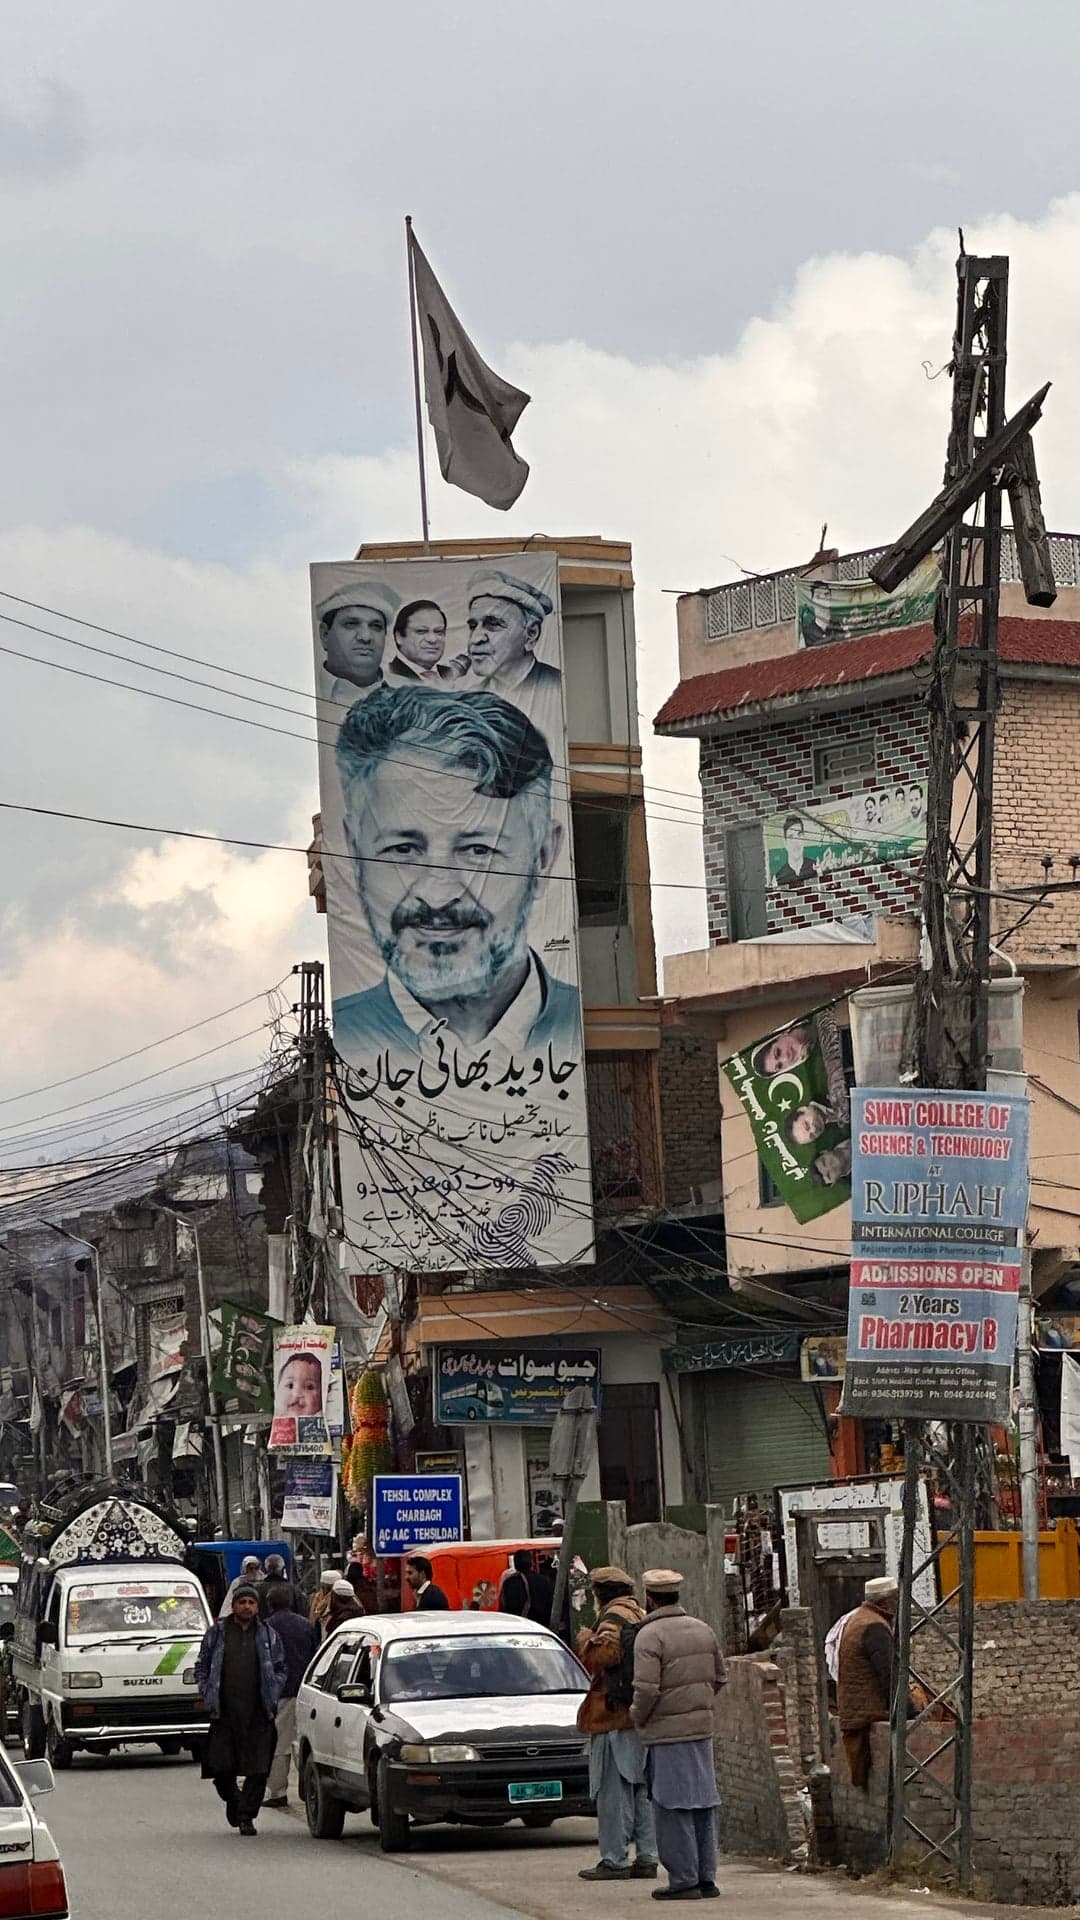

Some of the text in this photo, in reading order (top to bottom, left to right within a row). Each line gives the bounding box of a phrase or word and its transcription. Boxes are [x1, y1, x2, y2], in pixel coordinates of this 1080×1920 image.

[346, 1019, 578, 1107] جاوید بھائی جان
[493, 1104, 541, 1144] تحصیل
[865, 1100, 1009, 1130] SWAT COLLEGE OF
[861, 1134, 1011, 1160] SCIENCE & TECHNOLOGY
[928, 1165, 942, 1177] AT
[865, 1181, 1004, 1219] RIPHAH
[861, 1225, 1004, 1242] INTERNATIONAL COLLEGE
[860, 1265, 1004, 1286] ADMISSIONS OPEN
[900, 1295, 960, 1315] 2 Years
[860, 1317, 998, 1352] Pharmacy B
[497, 1353, 555, 1382] سوات
[556, 1358, 597, 1382] جیو
[382, 1488, 452, 1502] TEHSIL COMPLEX
[396, 1509, 442, 1522] CHARBAGH
[378, 1527, 459, 1541] AC AAC TEHSILDAR
[123, 1678, 163, 1686] SUZUKI
